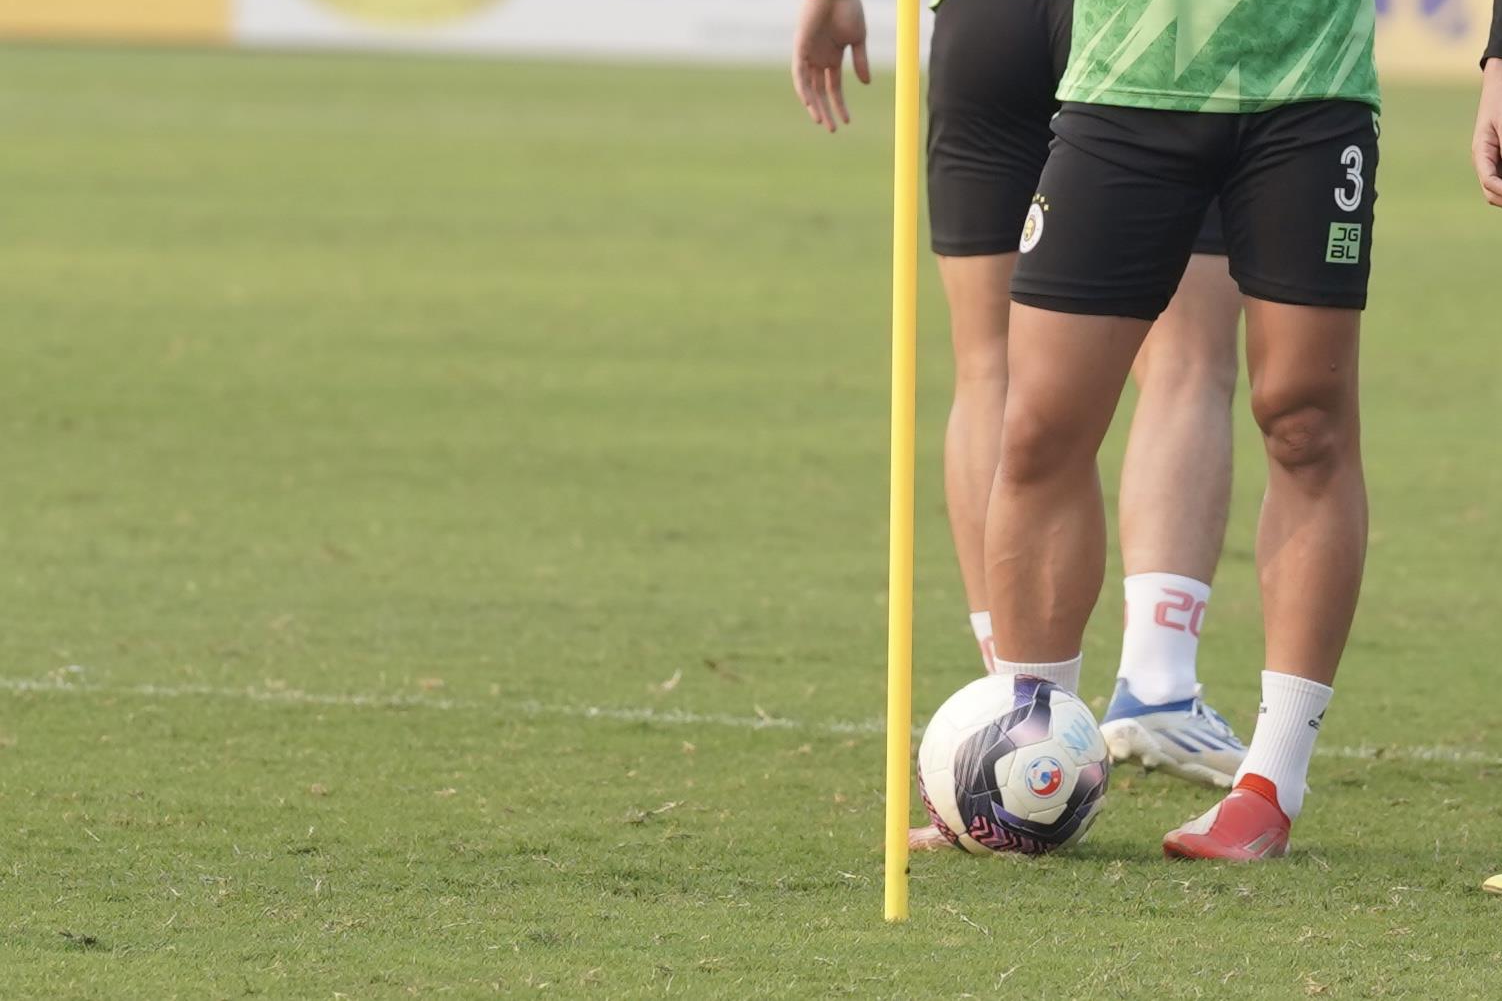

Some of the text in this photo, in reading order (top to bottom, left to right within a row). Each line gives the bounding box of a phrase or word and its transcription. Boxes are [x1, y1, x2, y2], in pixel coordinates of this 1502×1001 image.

[1334, 145, 1364, 212] 3
[1332, 227, 1359, 242] JG
[1330, 245, 1357, 259] BL
